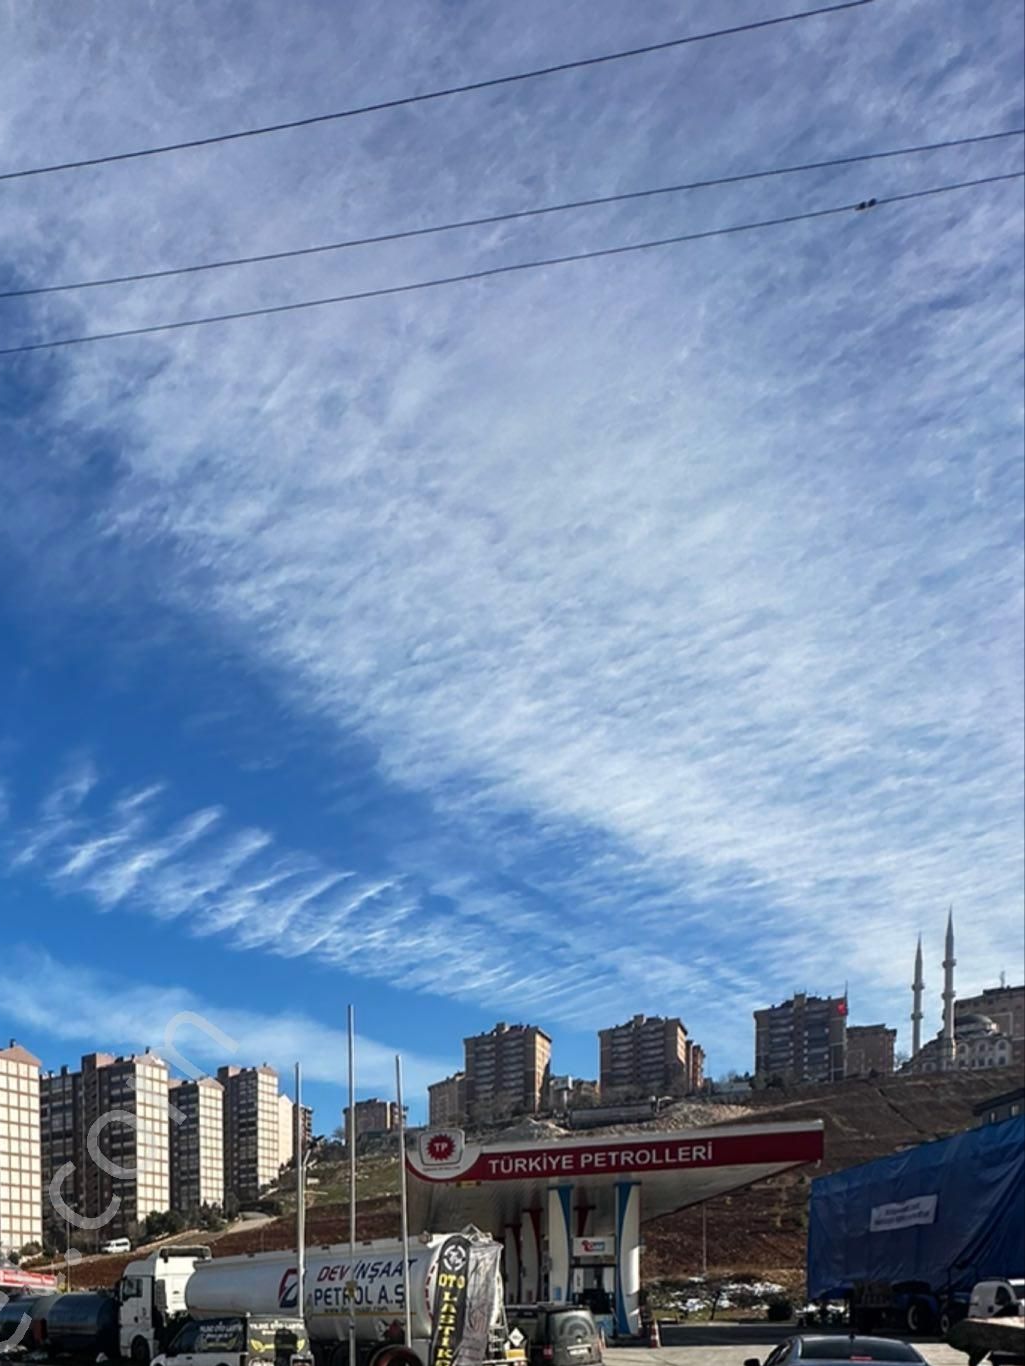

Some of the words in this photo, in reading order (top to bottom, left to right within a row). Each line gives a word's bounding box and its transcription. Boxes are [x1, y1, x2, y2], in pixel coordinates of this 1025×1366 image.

[433, 1141, 449, 1152] TP
[489, 1152, 574, 1174] TÜRKİYE
[580, 1142, 713, 1168] PETROLLERİ
[317, 1263, 350, 1282] DEV
[438, 1274, 466, 1289] OTO
[314, 1285, 373, 1306] PETROL
